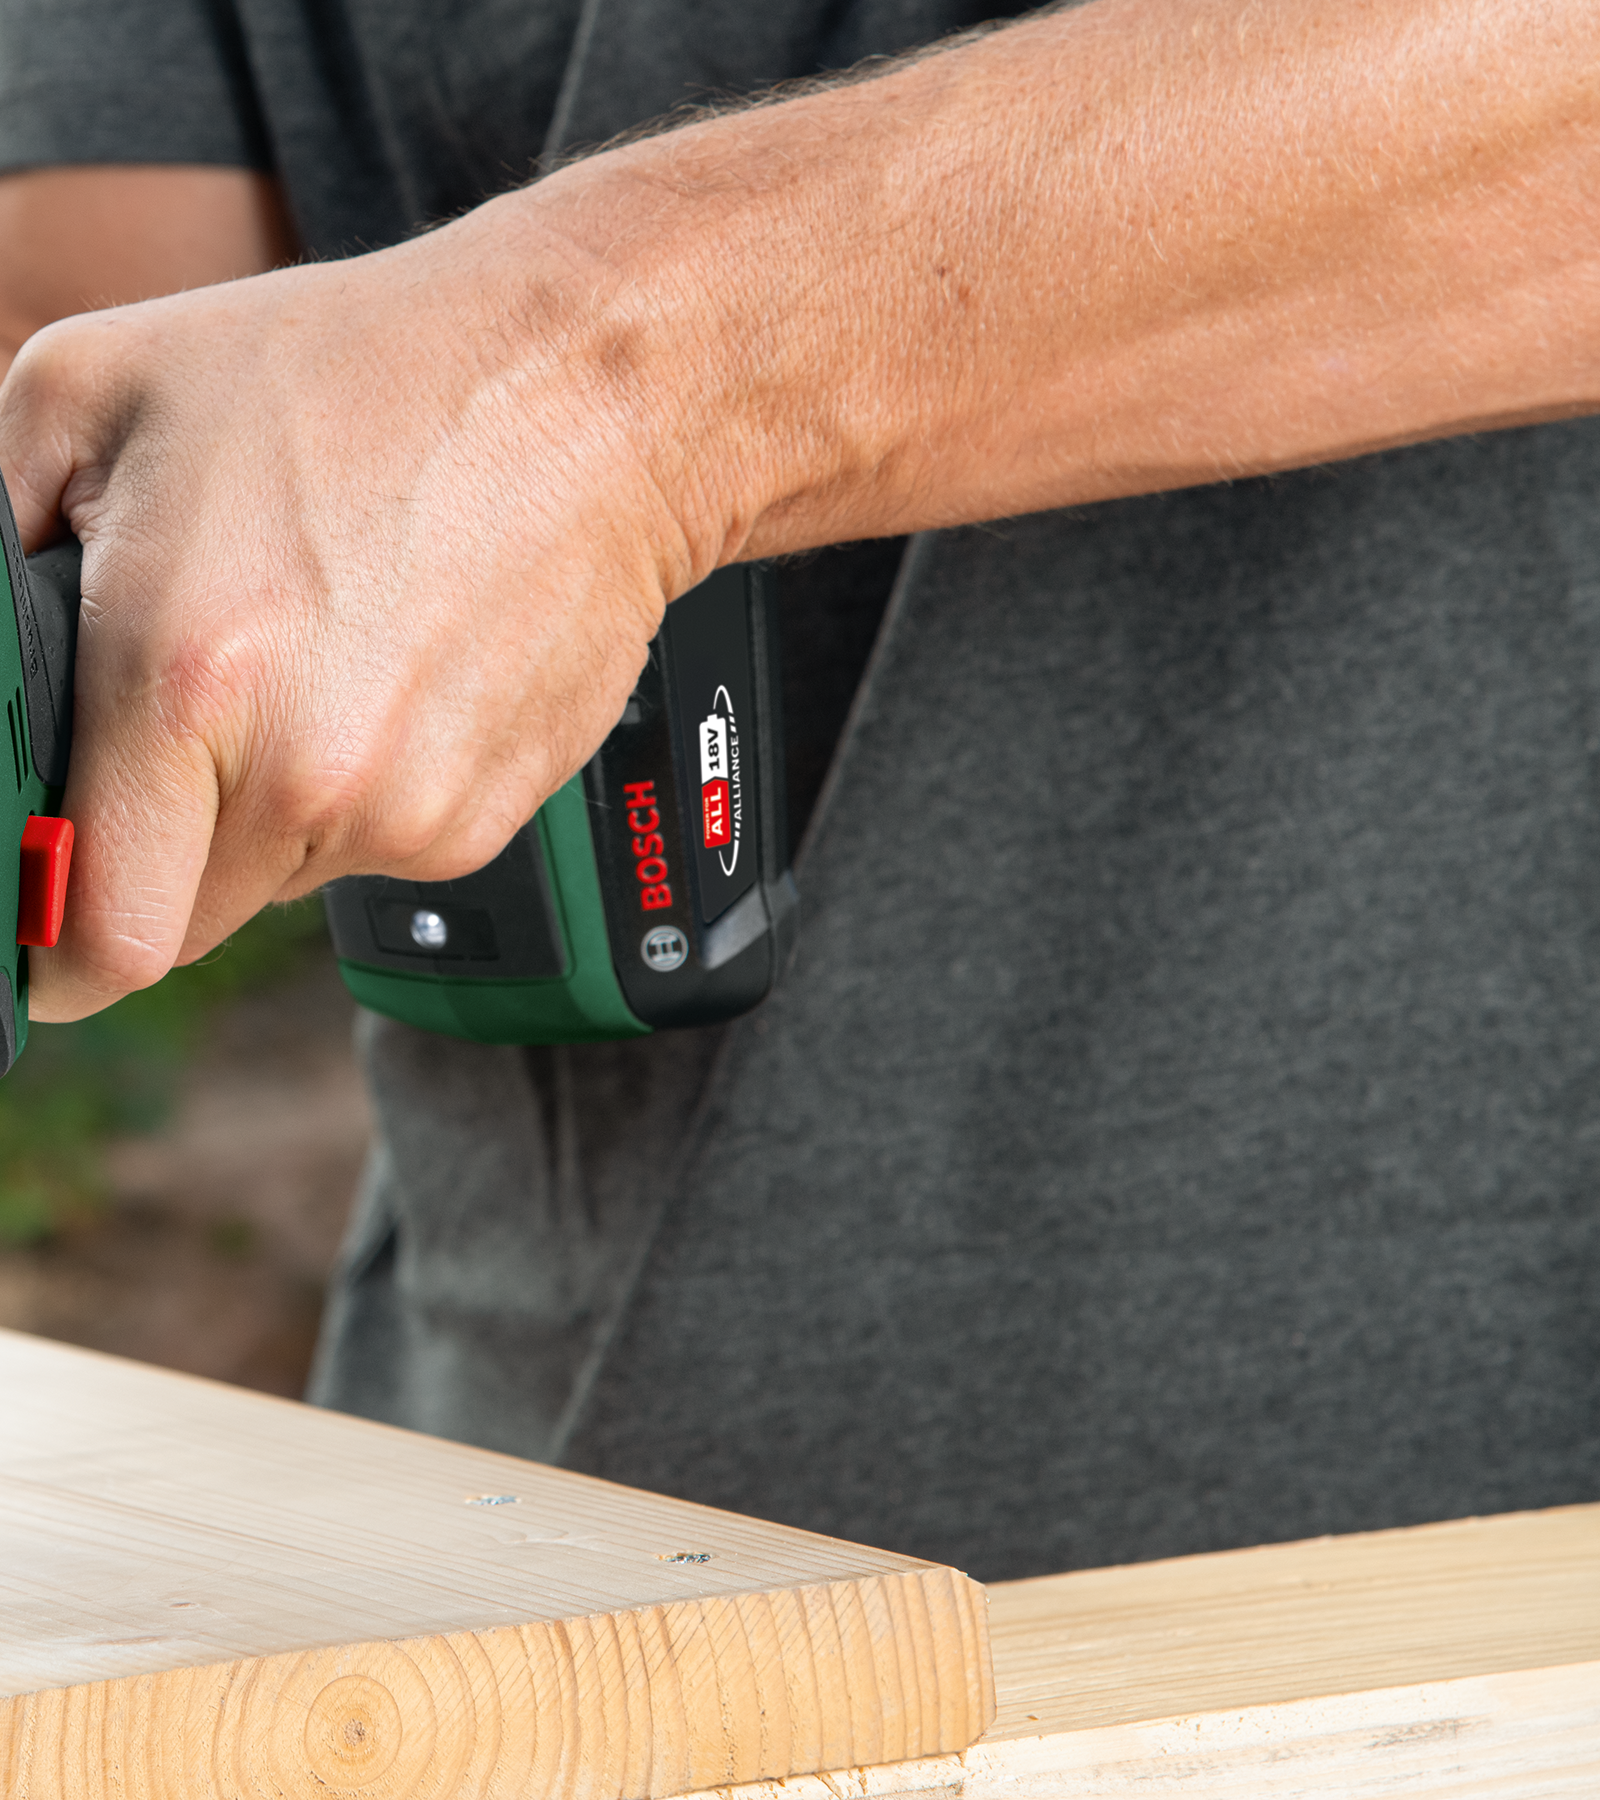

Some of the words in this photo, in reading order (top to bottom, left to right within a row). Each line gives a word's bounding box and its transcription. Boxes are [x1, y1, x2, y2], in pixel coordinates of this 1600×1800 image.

[707, 727, 721, 771] 18V
[730, 735, 742, 821] ALLIANCE
[710, 787, 723, 836] ALL
[624, 780, 673, 911] BOSCH
